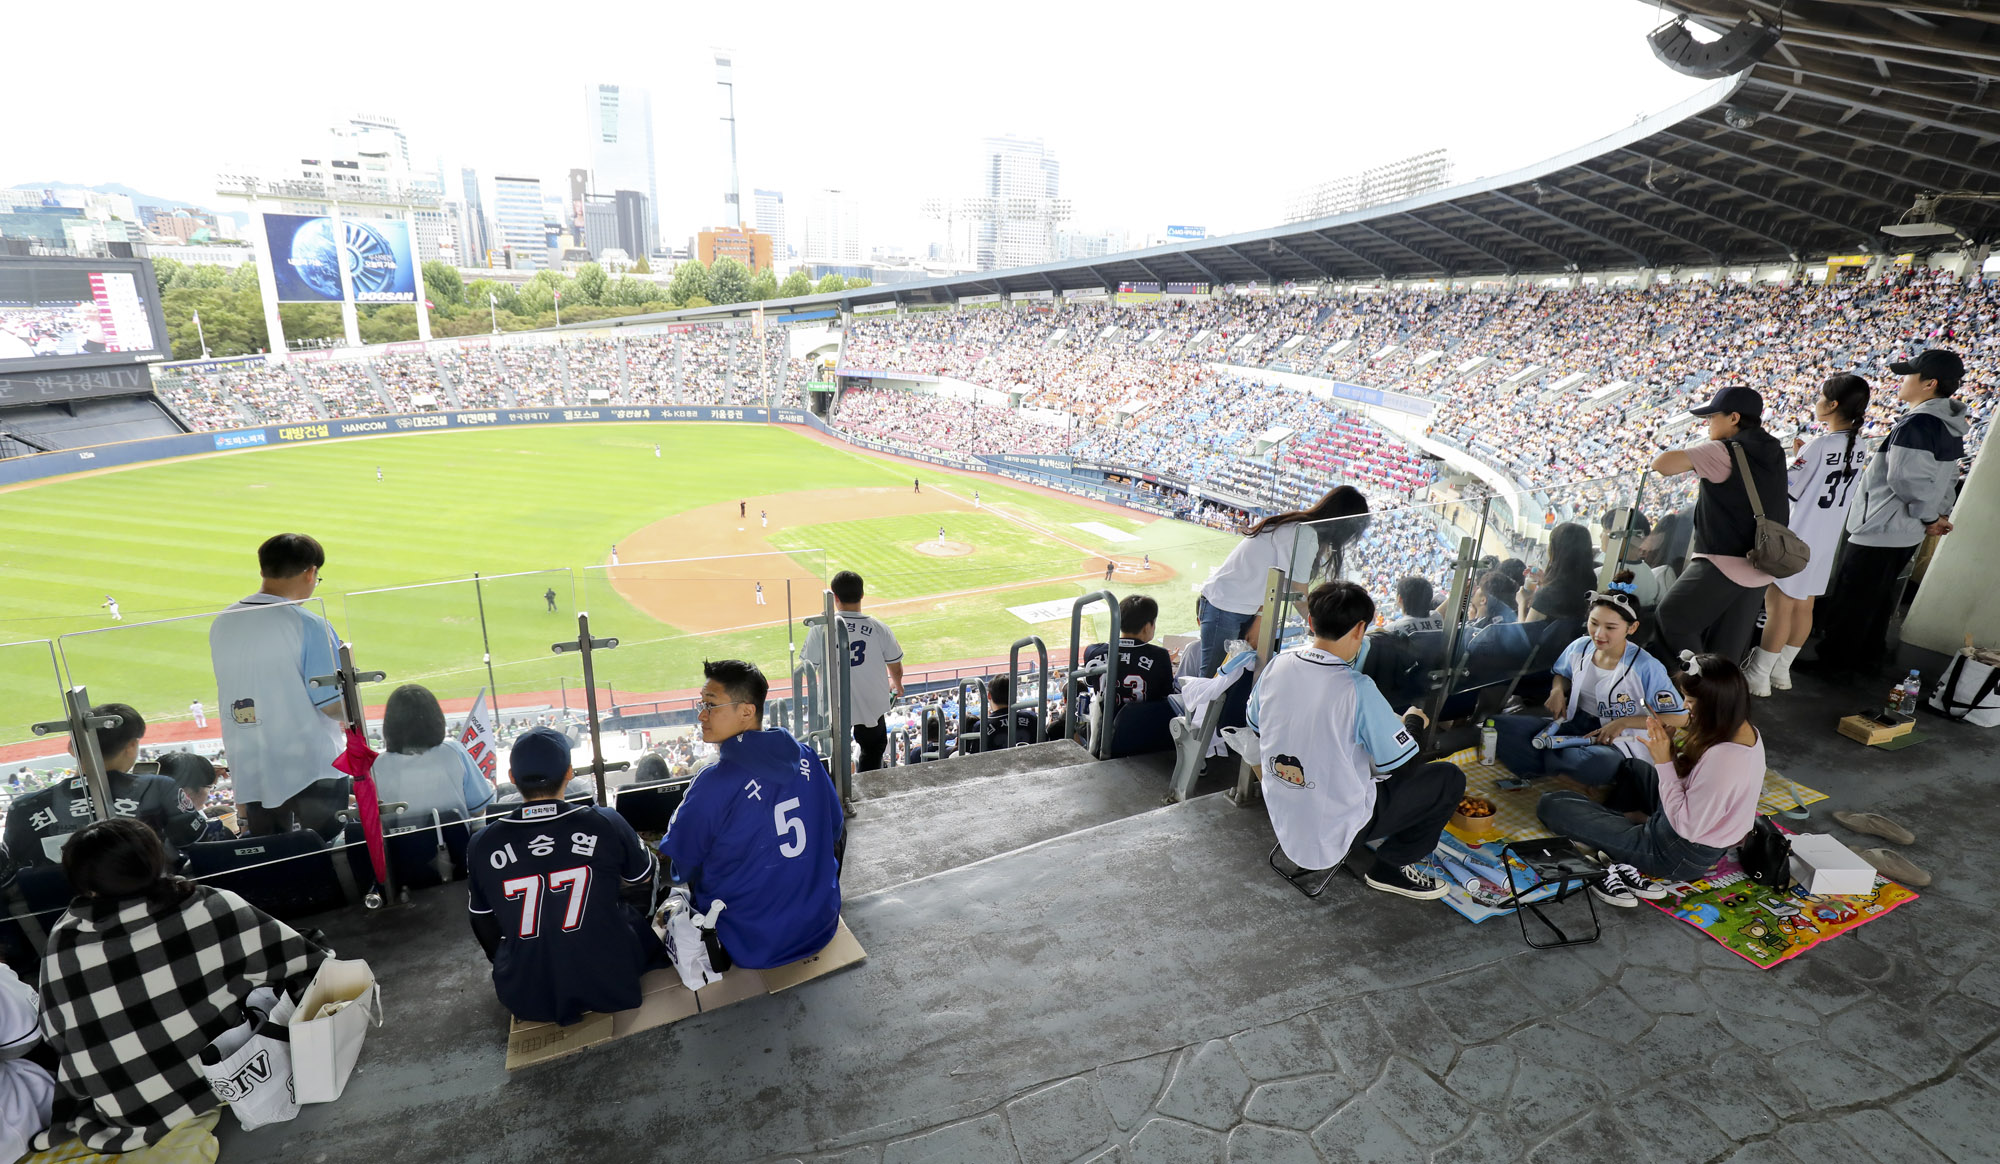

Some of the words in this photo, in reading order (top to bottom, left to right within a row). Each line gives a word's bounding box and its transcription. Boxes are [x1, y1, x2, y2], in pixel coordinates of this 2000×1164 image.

[358, 291, 414, 301] DOOSAN
[35, 369, 140, 395] 한국경제TV
[457, 412, 498, 424] 치킨마루
[509, 412, 550, 422] 한국경제TV
[673, 410, 698, 418] KB증권
[711, 409, 743, 420] 키움증권
[342, 421, 387, 433] HANCOM
[413, 416, 448, 428] 대보건설
[279, 424, 329, 440] 대방건설
[225, 434, 265, 446] 도미노피자
[1817, 468, 1859, 509] 37
[847, 622, 873, 637] 경민
[849, 640, 867, 668] 3
[661, 785, 677, 793] 220
[531, 806, 556, 814] 대화제약
[774, 796, 807, 859] 5
[240, 847, 259, 855] 223
[489, 831, 598, 870] 이승엽
[502, 864, 593, 940] 77
